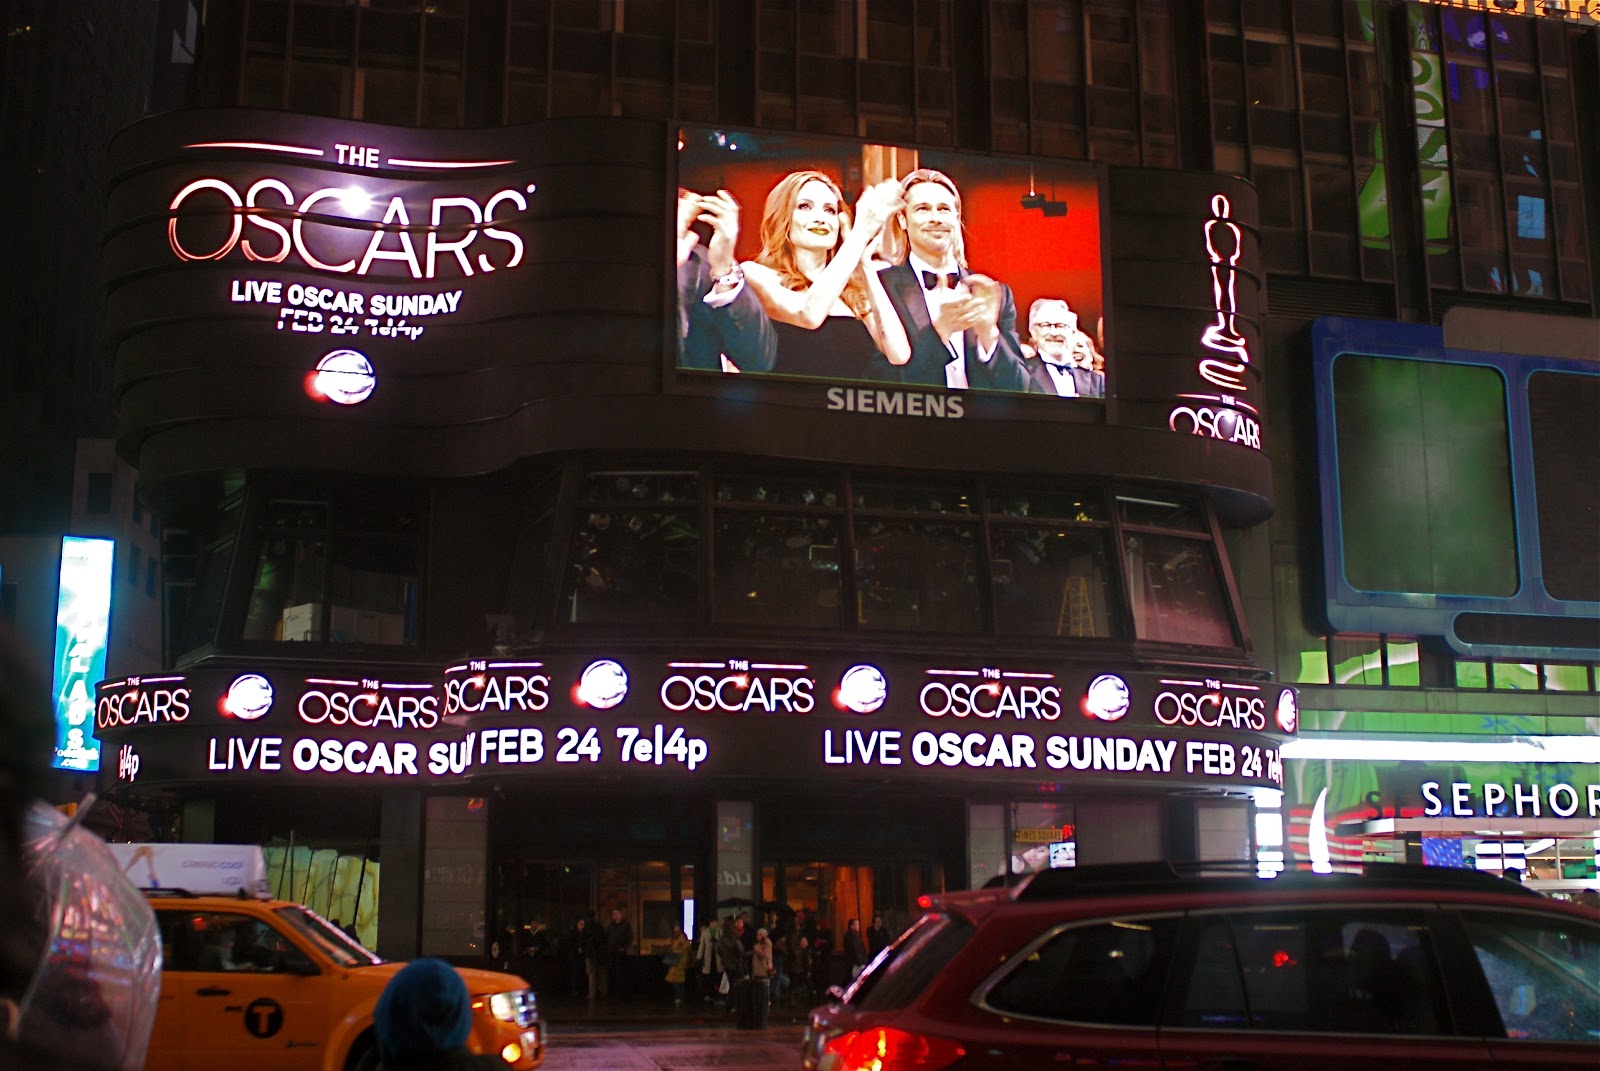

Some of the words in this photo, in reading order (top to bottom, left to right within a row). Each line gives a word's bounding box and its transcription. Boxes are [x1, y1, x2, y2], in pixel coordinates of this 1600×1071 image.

[335, 144, 379, 168] THE
[169, 178, 527, 278] OSCARS
[232, 281, 282, 303] LIVE
[287, 284, 363, 313] OSCAR
[370, 290, 462, 316] SUNDAY
[277, 308, 325, 332] FEB
[329, 315, 360, 335] 24
[827, 387, 964, 418] SIEMENS
[1221, 394, 1236, 405] THE
[127, 677, 140, 686] THE
[470, 661, 486, 671] THE
[729, 660, 749, 671] THE
[982, 668, 1000, 679] THE
[361, 679, 379, 690] THE
[443, 676, 549, 716] SCARS
[661, 675, 814, 713] OSCARS
[1205, 679, 1221, 690] THE
[98, 688, 190, 728] OSCARS
[299, 690, 437, 728] OSCARS
[920, 683, 1061, 721] OSCARS
[1155, 692, 1265, 730] OSCARS
[209, 738, 282, 770] LIVE
[293, 739, 417, 775] OSCAR
[481, 729, 543, 764] FEB
[556, 728, 601, 762] 24
[824, 730, 901, 765] LIVE
[912, 732, 1036, 768] OSCAR
[1046, 736, 1177, 772] SUNDAY
[1186, 742, 1236, 775] FEB
[1241, 746, 1262, 778] 24
[252, 1005, 276, 1034] T
